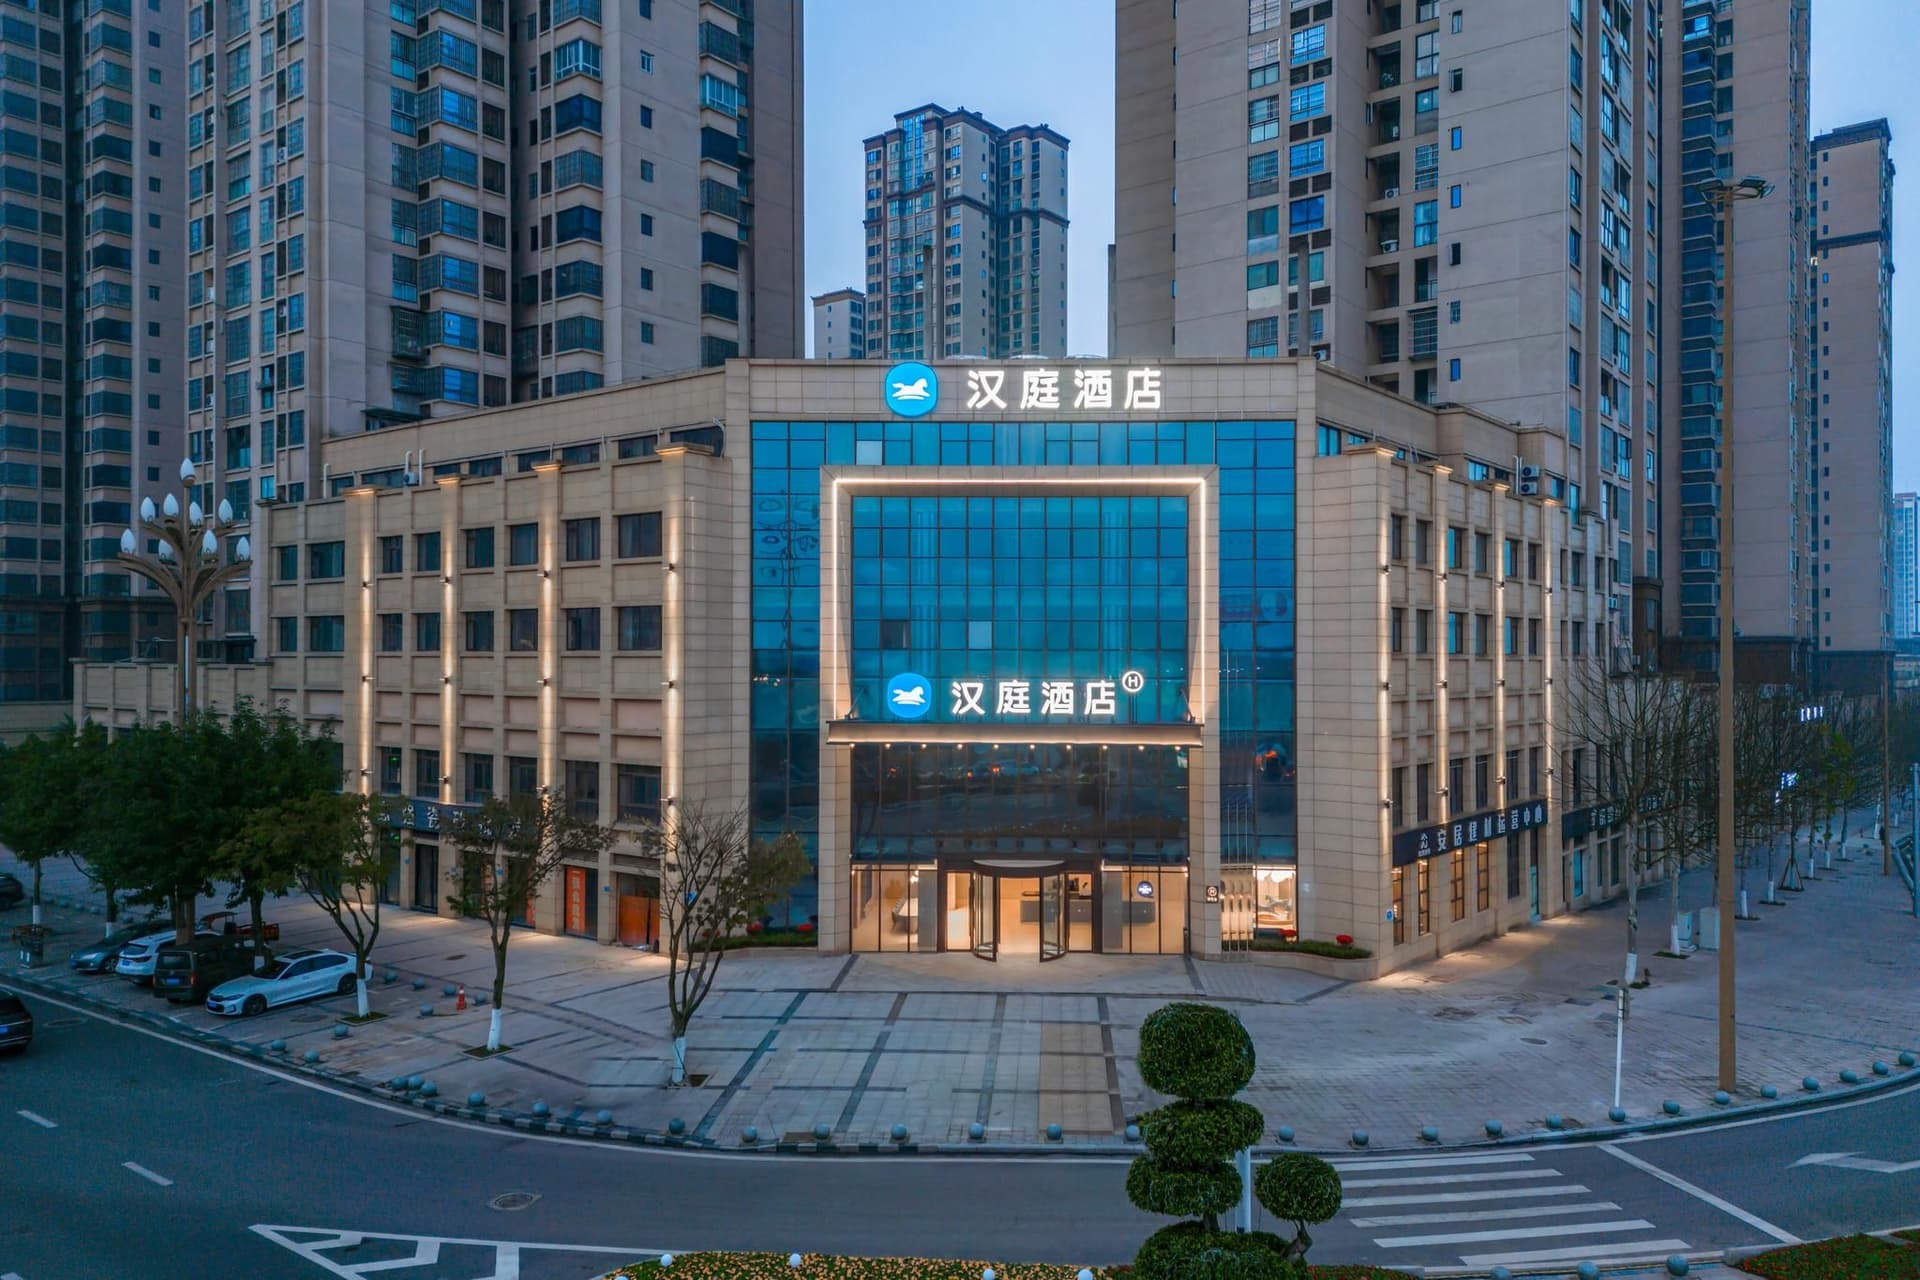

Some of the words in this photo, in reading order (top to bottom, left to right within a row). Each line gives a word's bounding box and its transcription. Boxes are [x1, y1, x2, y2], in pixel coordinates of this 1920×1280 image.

[966, 367, 1162, 410] 汉庭酒店
[950, 679, 1116, 716] 汉庭酒店
